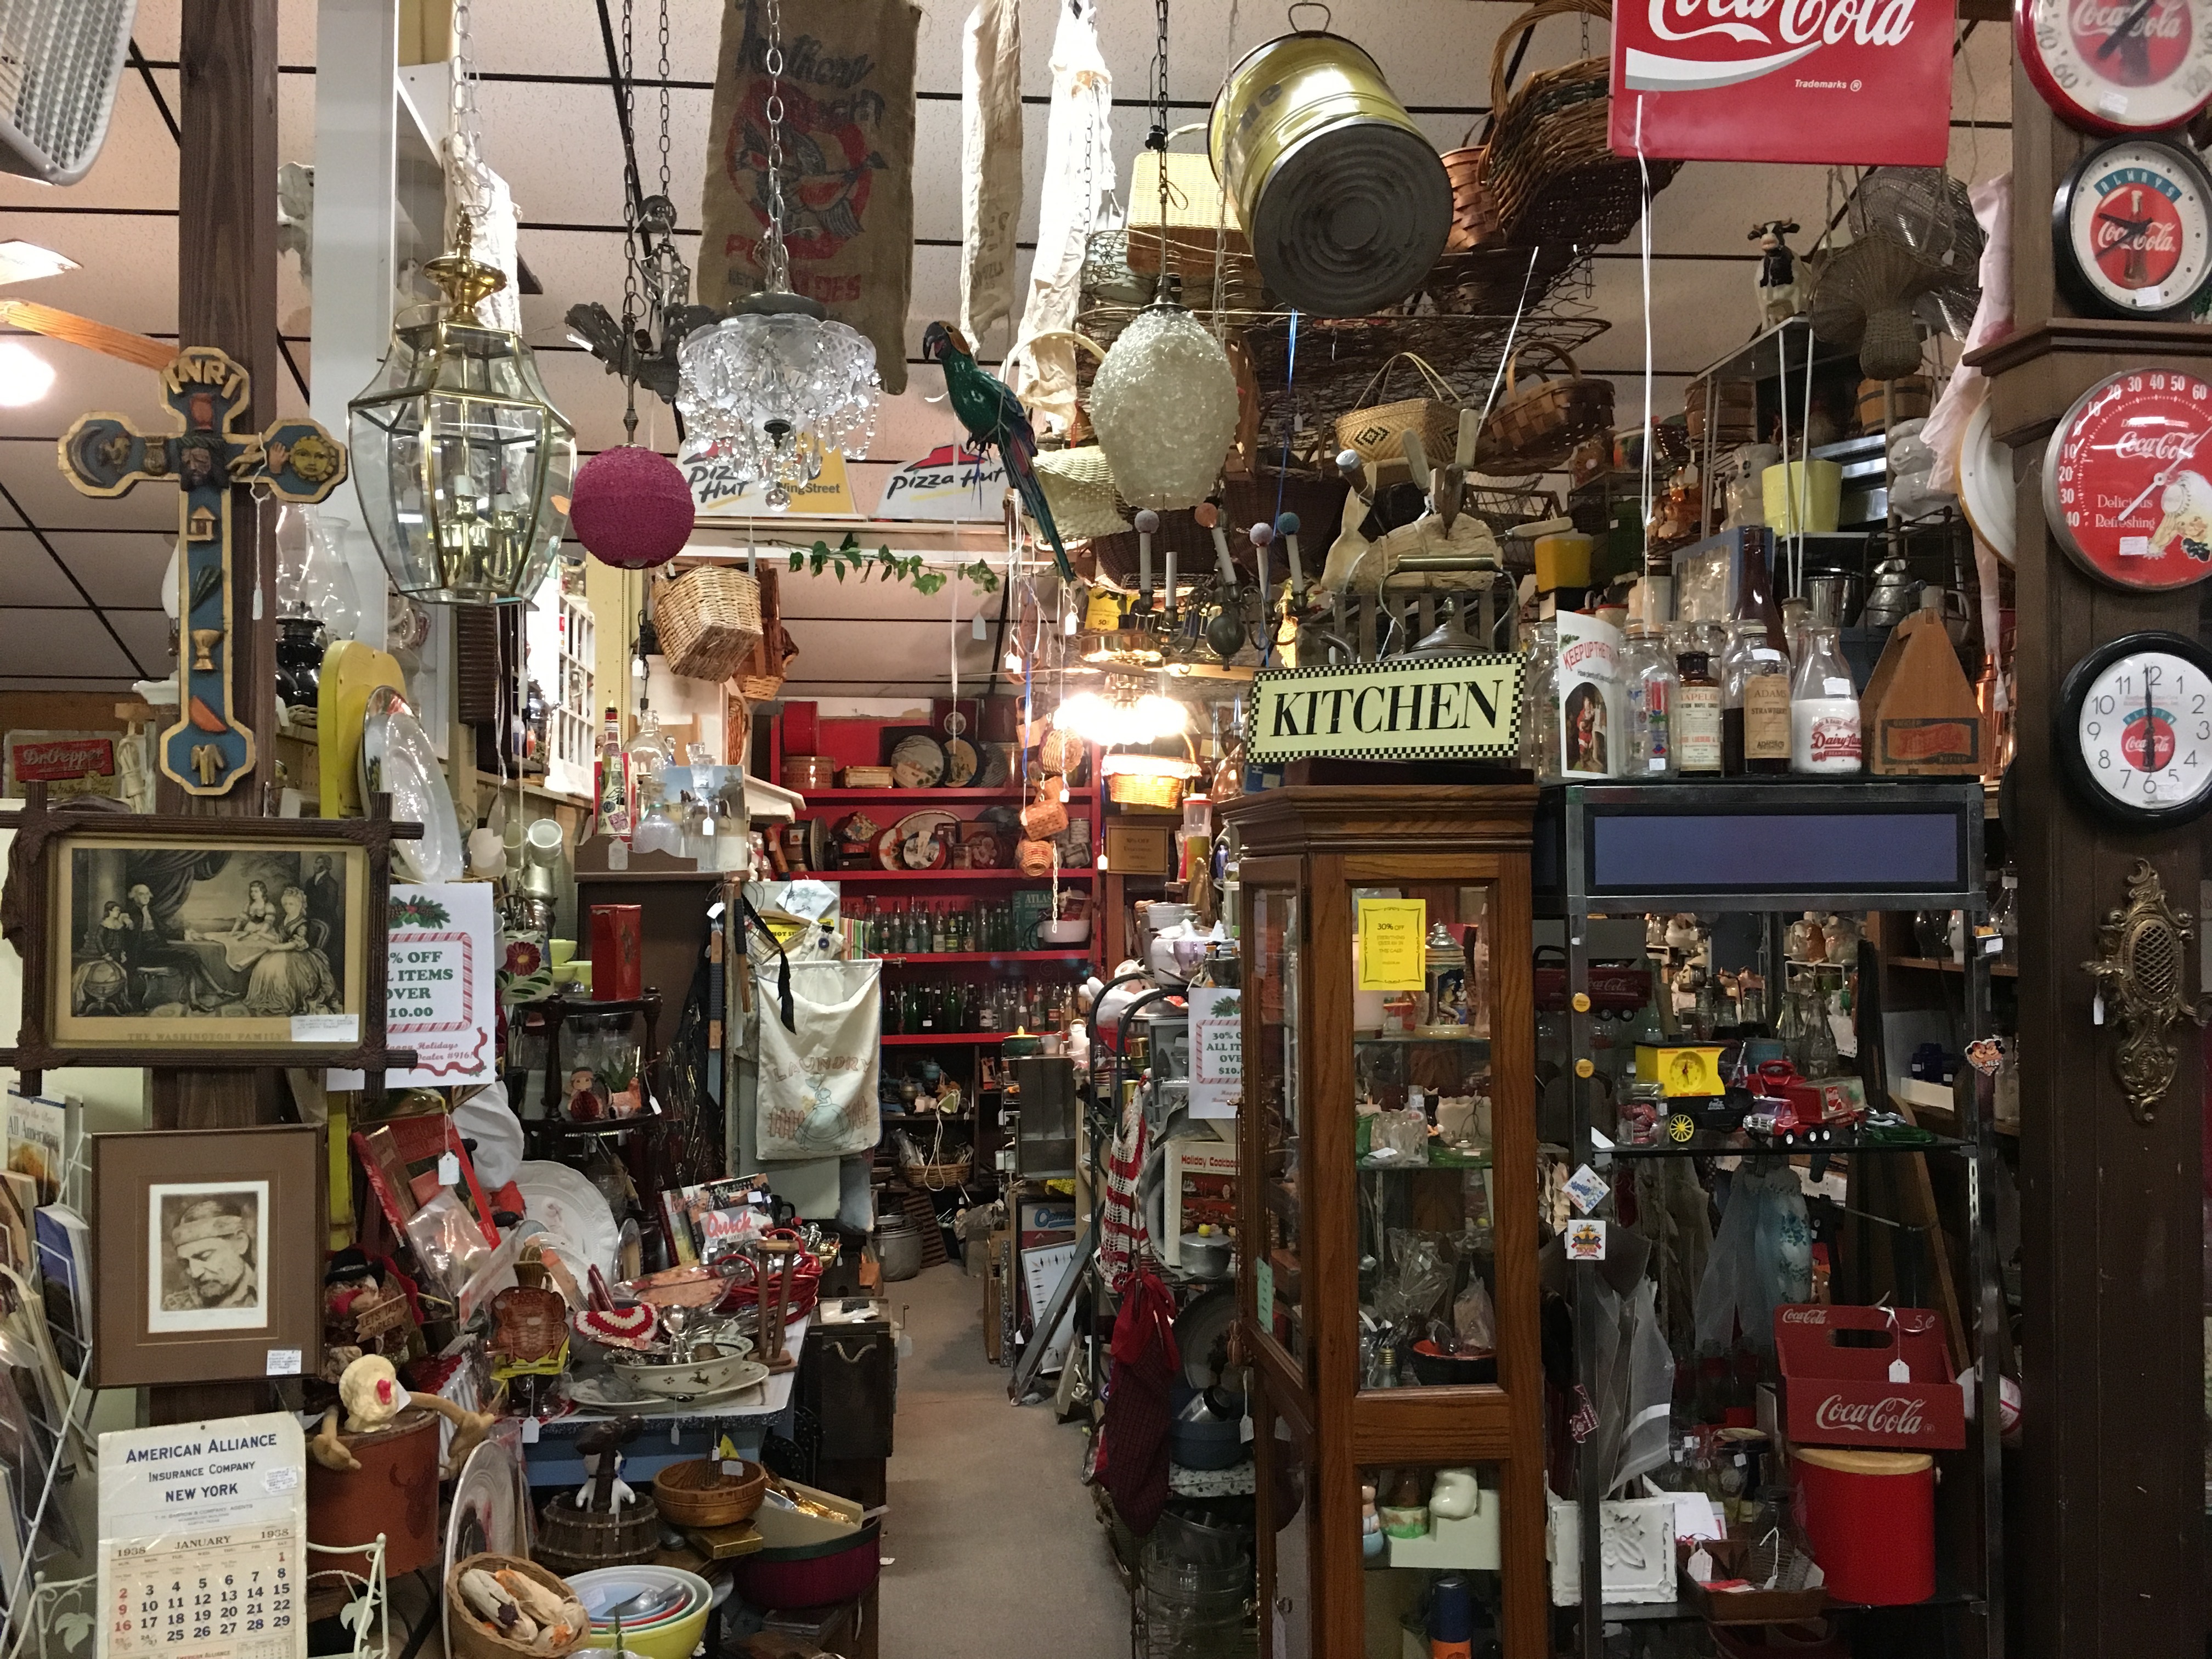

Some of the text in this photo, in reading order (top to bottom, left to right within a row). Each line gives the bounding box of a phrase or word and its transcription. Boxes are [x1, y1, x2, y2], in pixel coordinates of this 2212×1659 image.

[1648, 0, 1914, 46] CocaCola
[2073, 0, 2182, 38] CocaCola
[1795, 79, 1847, 89] Trademarks
[2100, 171, 2176, 197] ALWAYS
[166, 357, 241, 399] INRI
[2128, 376, 2142, 392] 30
[2150, 375, 2164, 390] 40
[2170, 375, 2185, 391] 50
[2192, 385, 2207, 400] 60
[689, 465, 739, 489] Piz
[887, 467, 1006, 499] Pizza Hut
[2059, 466, 2073, 482] 20
[699, 481, 754, 503] Hut
[2061, 488, 2074, 504] 30
[2097, 494, 2153, 508] Delicius
[2066, 511, 2080, 527] 40
[2095, 514, 2155, 531] Refreshing
[1563, 644, 1583, 671] KEEP
[1584, 641, 1594, 658] UP
[2115, 665, 2183, 695] 11 12 1
[1754, 689, 1787, 698] ADAMS
[1270, 680, 1503, 737] KITCHEN
[2092, 695, 2205, 714] 10 2
[1810, 731, 1846, 748] Dairy
[2087, 720, 2210, 741] 9 3
[2098, 749, 2198, 769] 8 4
[2120, 769, 2180, 794] 7 6 5
[1025, 894, 1052, 903] ATLAS
[408, 951, 442, 963] OFF
[398, 969, 453, 981] ITEMS
[389, 1007, 433, 1018] 10.00
[128, 1032, 283, 1042] THE WASHINGTON FAMILY
[774, 1057, 872, 1082] LAUNDRY
[1182, 1155, 1207, 1167] Holiday
[707, 1210, 752, 1238] Quick
[1782, 1308, 1827, 1324] Coca-Cola
[1816, 1395, 1927, 1434] Coca-Cola
[126, 1434, 277, 1464] AMERICAN ALLIANCE
[149, 1461, 256, 1482] INSURANCE COMPANY
[166, 1483, 238, 1502] NEW YORK
[117, 1528, 289, 1557] 1938 JANUARY 1938
[279, 1552, 285, 1562] 1
[119, 1567, 286, 1599] 2 3 4 5 6 7 8
[118, 1583, 290, 1615] 9 10 11 12 13 14 15
[115, 1599, 290, 1632] 16 17 18 19 20 21 22
[167, 1630, 184, 1641] 25
[193, 1626, 211, 1638] 26
[220, 1622, 237, 1634] 27
[246, 1618, 264, 1630] 28
[273, 1615, 290, 1627] 29
